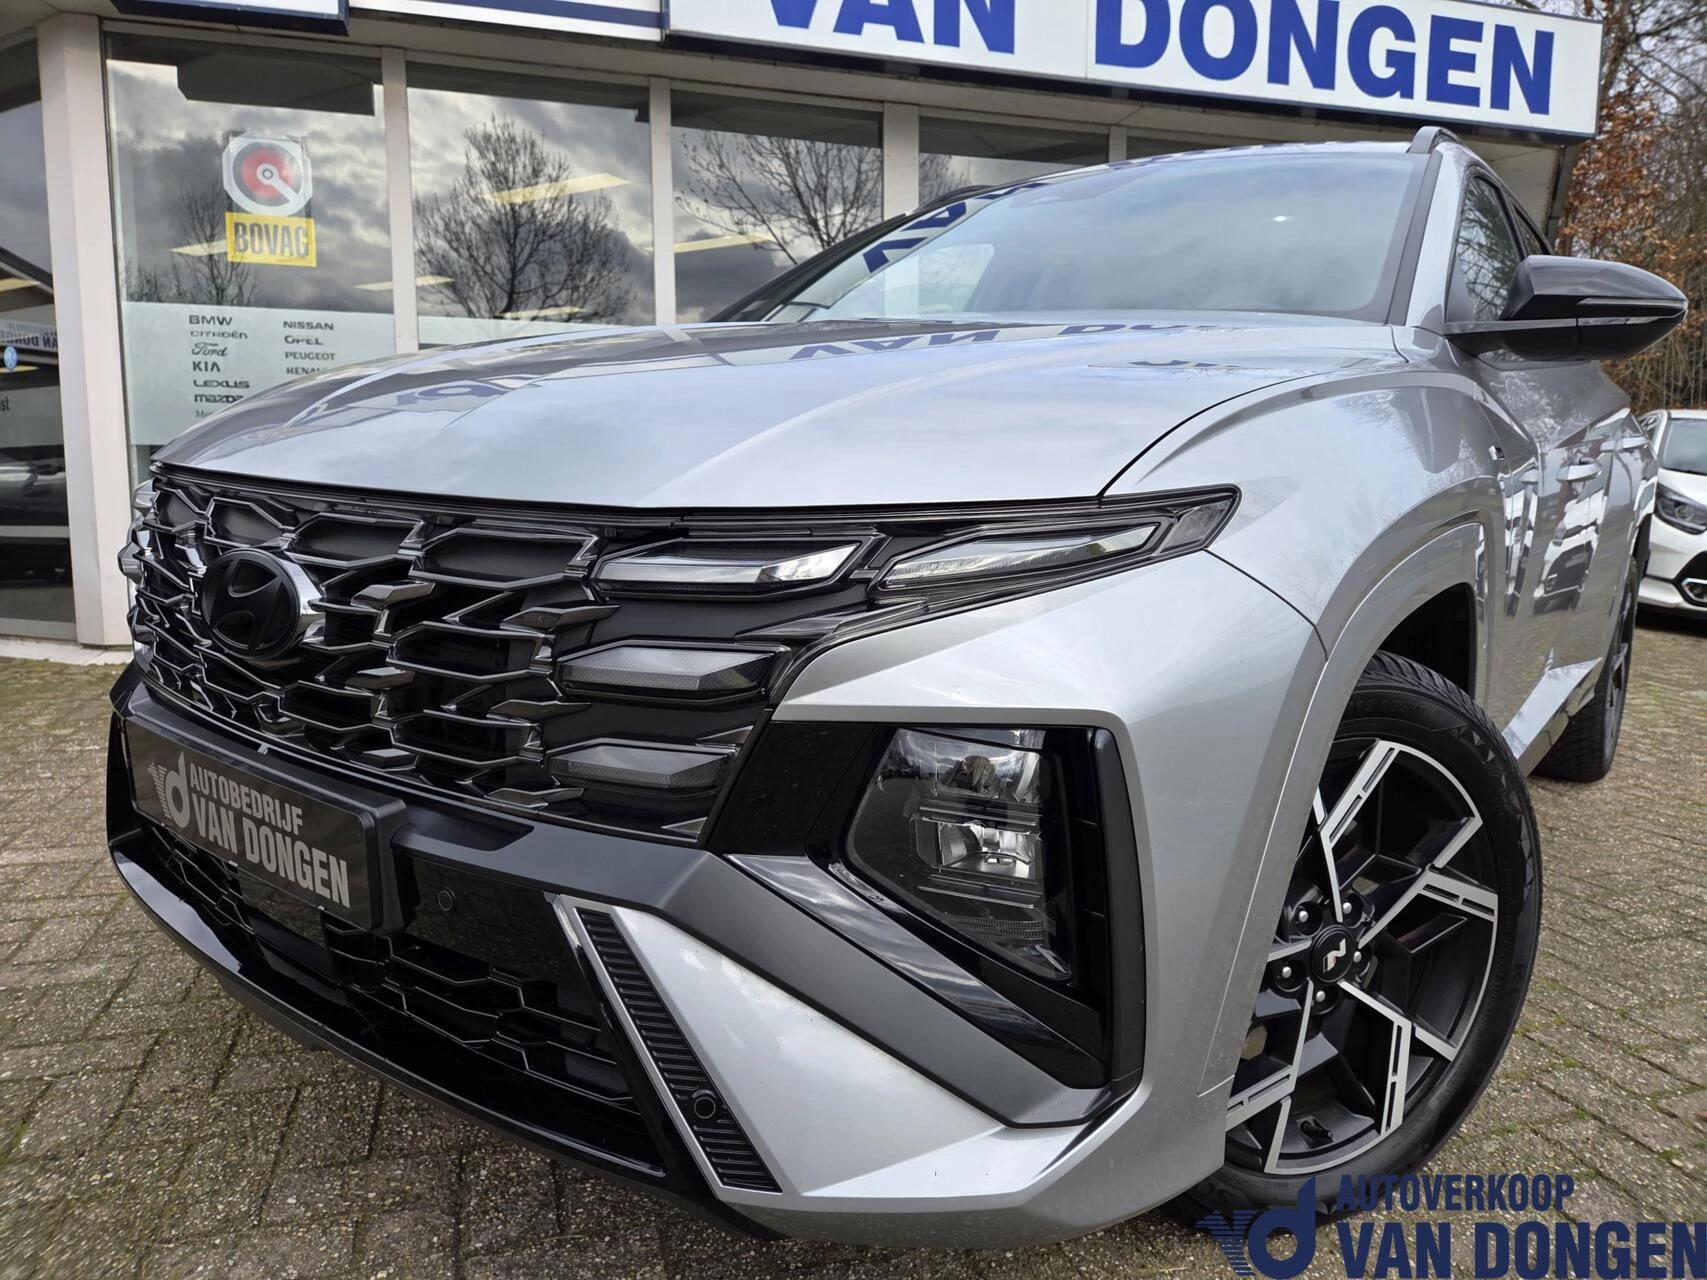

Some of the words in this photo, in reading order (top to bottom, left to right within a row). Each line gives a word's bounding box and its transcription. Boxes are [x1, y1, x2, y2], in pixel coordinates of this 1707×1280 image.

[1096, 0, 1554, 115] DONGEN
[233, 221, 309, 257] BOVAG
[189, 315, 232, 326] BMW
[283, 321, 334, 331] NISSAN
[284, 335, 324, 346] OPEL
[191, 342, 228, 357] Ford
[285, 351, 336, 361] PEUGEOT
[192, 361, 221, 372] KIA
[286, 366, 321, 375] RENA
[193, 379, 250, 389] LEXUS
[190, 763, 303, 836] AUTOBEDRIJF
[192, 792, 238, 854] VAN
[242, 817, 350, 909] DONGEN
